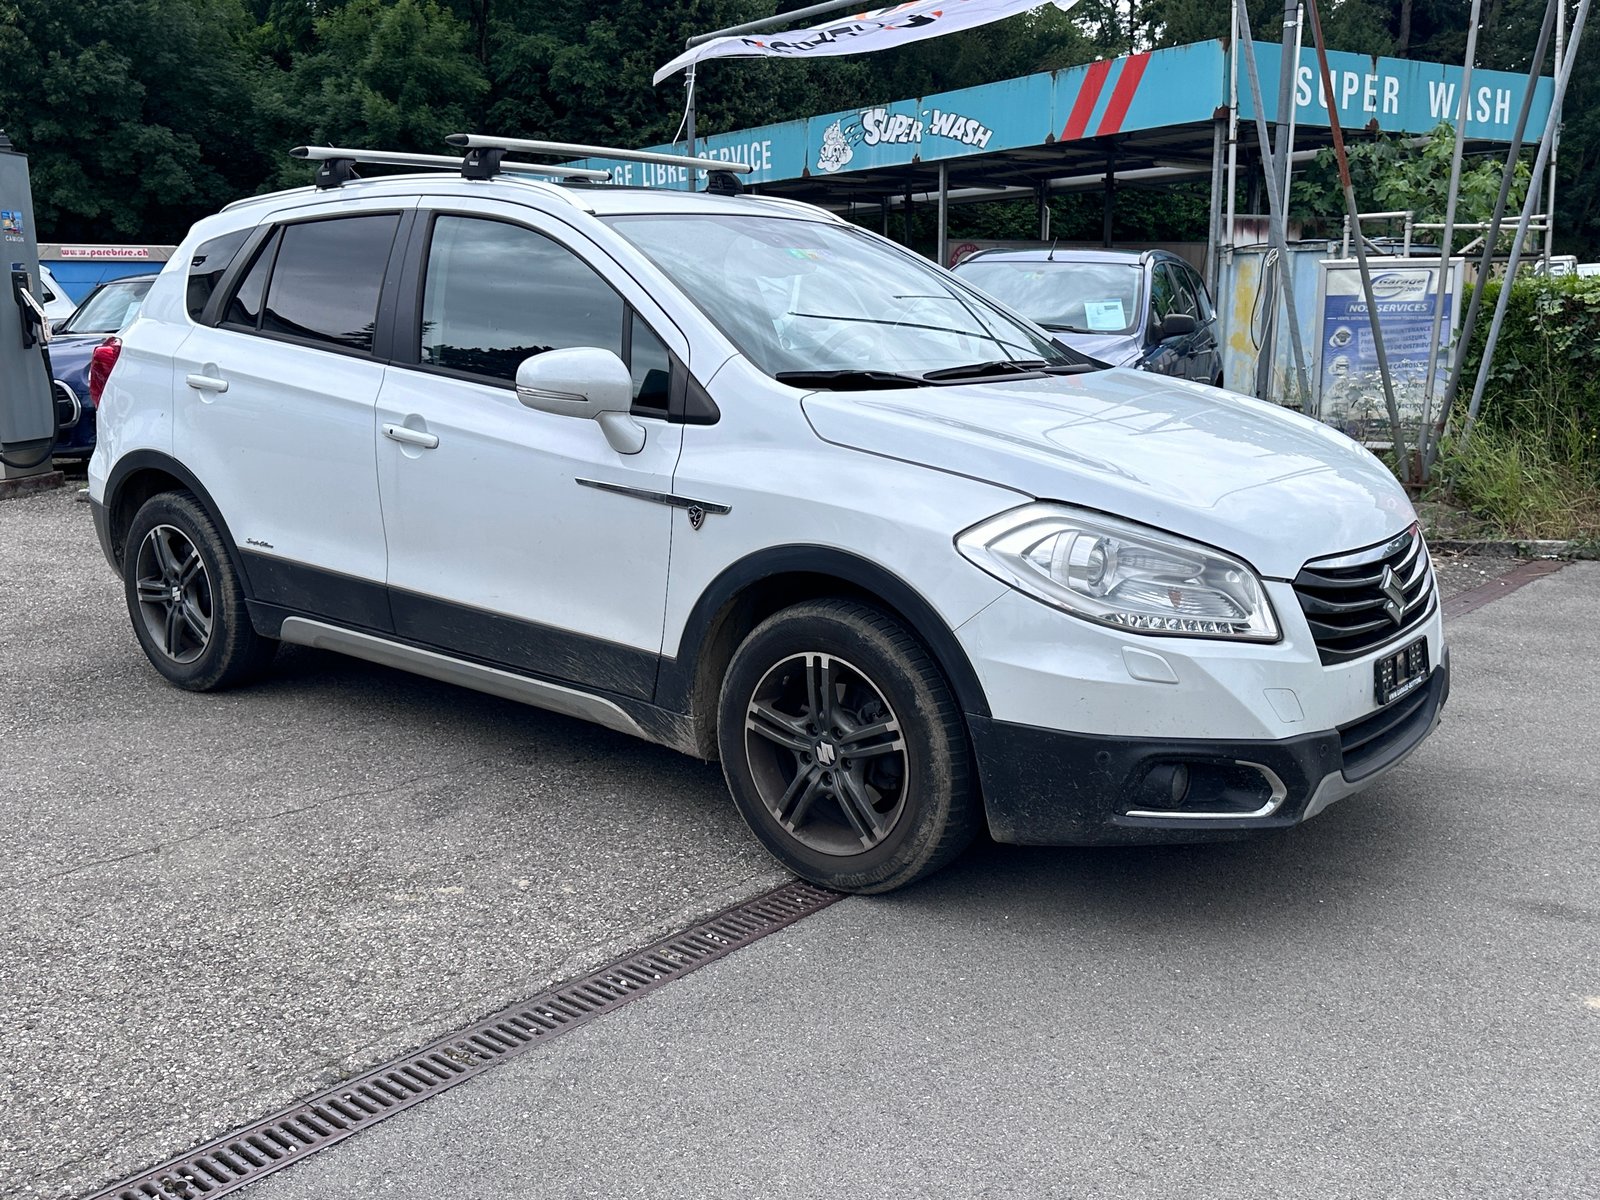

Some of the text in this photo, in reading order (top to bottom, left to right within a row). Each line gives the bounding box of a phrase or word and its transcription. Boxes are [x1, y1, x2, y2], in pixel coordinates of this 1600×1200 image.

[1296, 66, 1399, 114] SUPER
[861, 108, 993, 149] SUPER WASH
[642, 158, 687, 187] LIBRE
[1376, 302, 1428, 312] SERVICES
